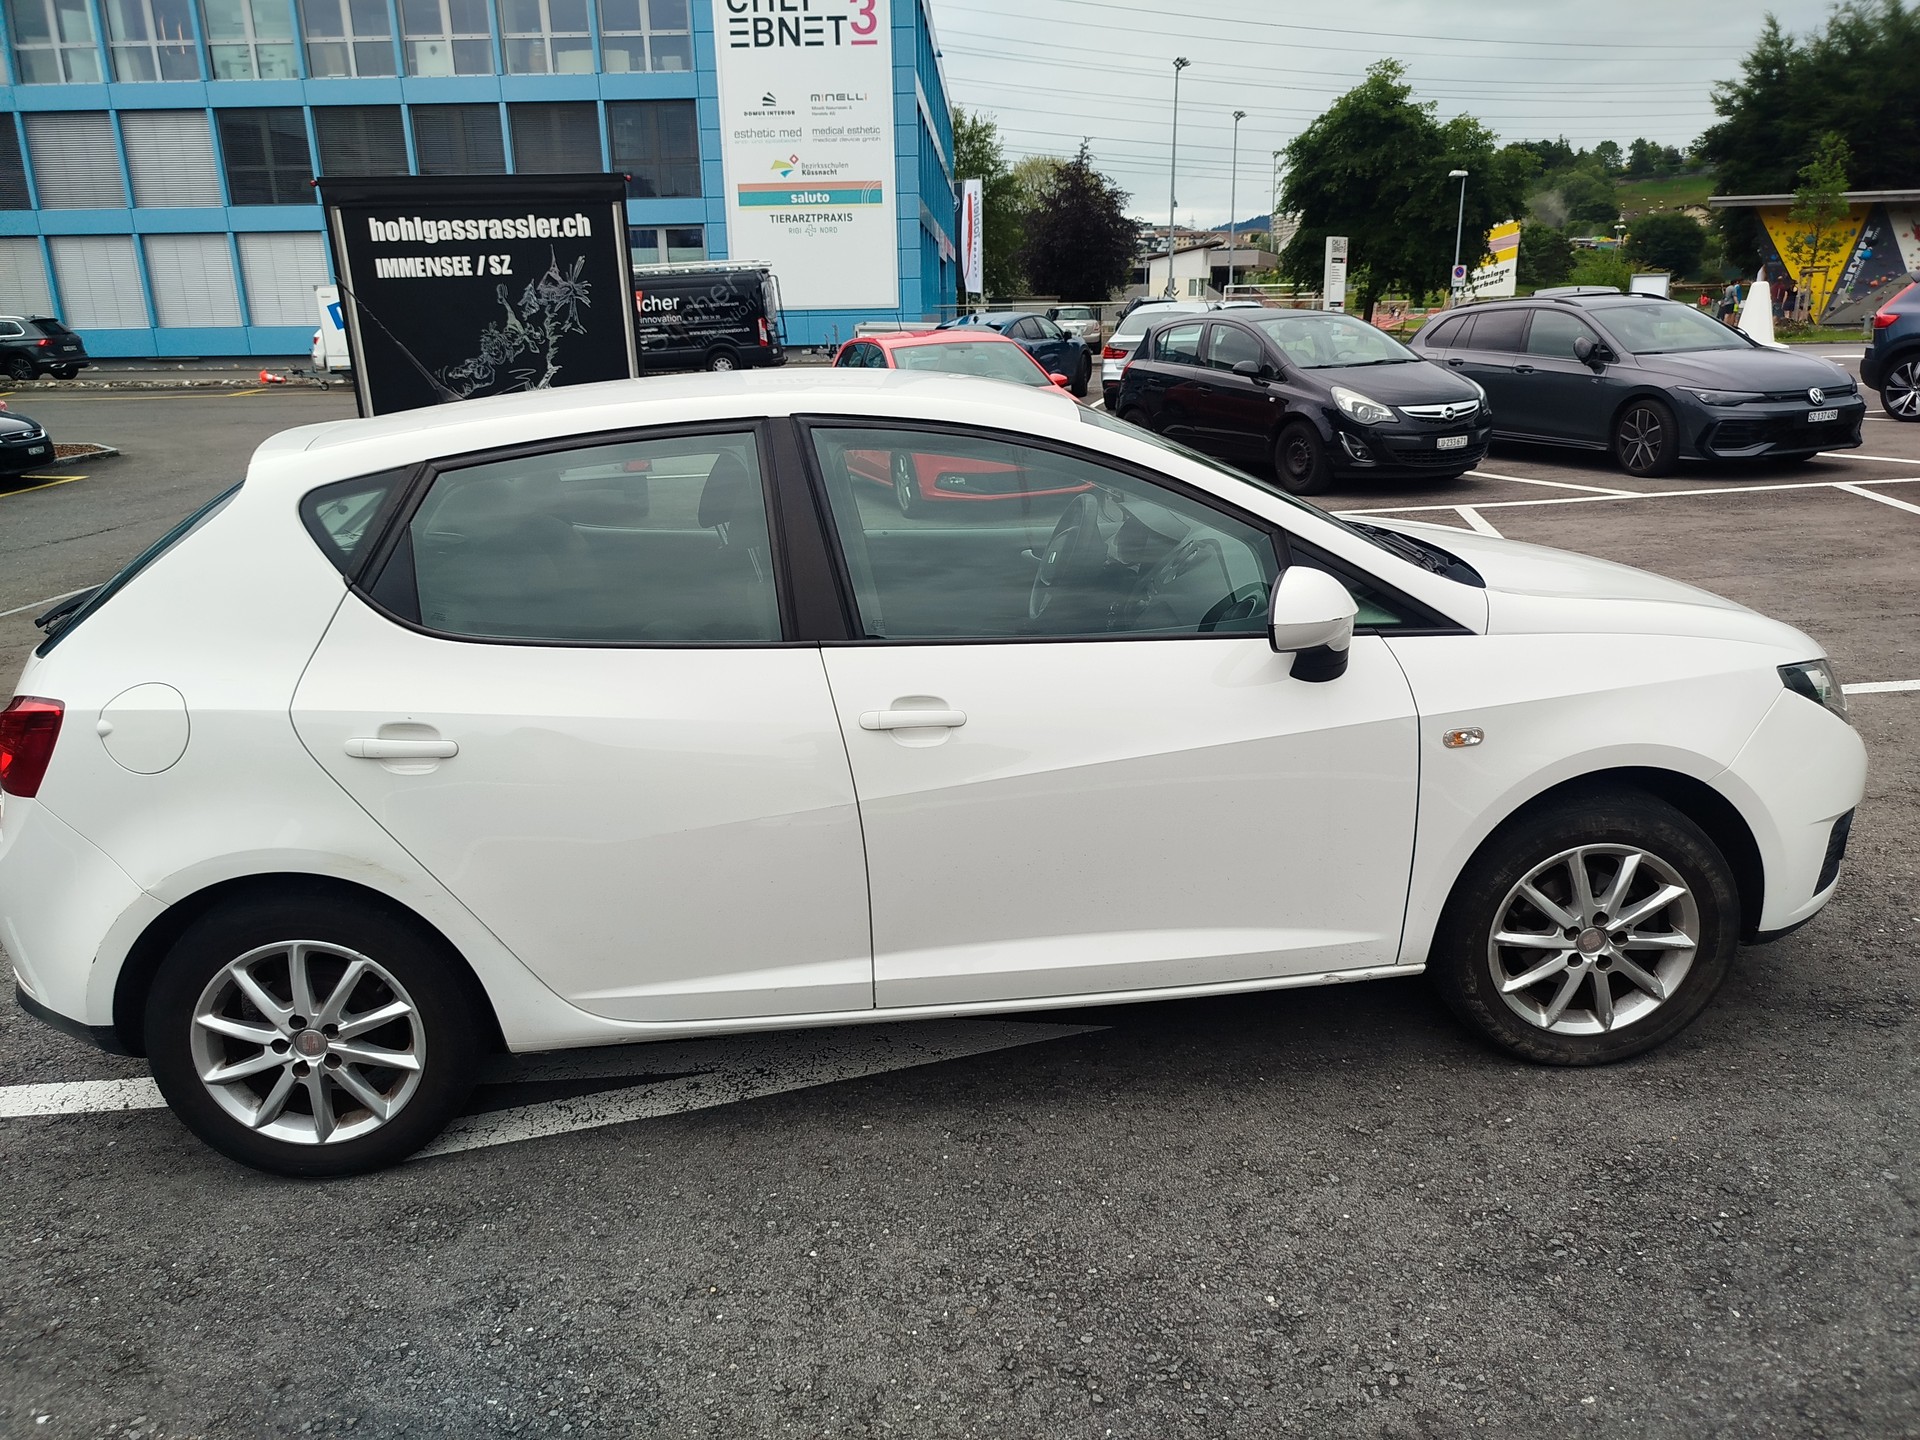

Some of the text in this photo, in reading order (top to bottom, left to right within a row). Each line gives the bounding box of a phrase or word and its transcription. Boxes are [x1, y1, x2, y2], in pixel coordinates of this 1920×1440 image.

[729, 0, 878, 48] EBNET 3
[734, 127, 803, 138] esthetic med
[812, 125, 881, 135] medical esthetic
[790, 192, 830, 203] saluto
[769, 213, 853, 224] TIERARZTPRAXIS
[368, 213, 591, 244] hohlgassrassler.ch
[375, 256, 473, 279] IMMENSEE
[488, 255, 513, 275] SZ
[1472, 268, 1511, 282] rtanlage
[636, 294, 680, 313] icher
[639, 314, 683, 324] innovation
